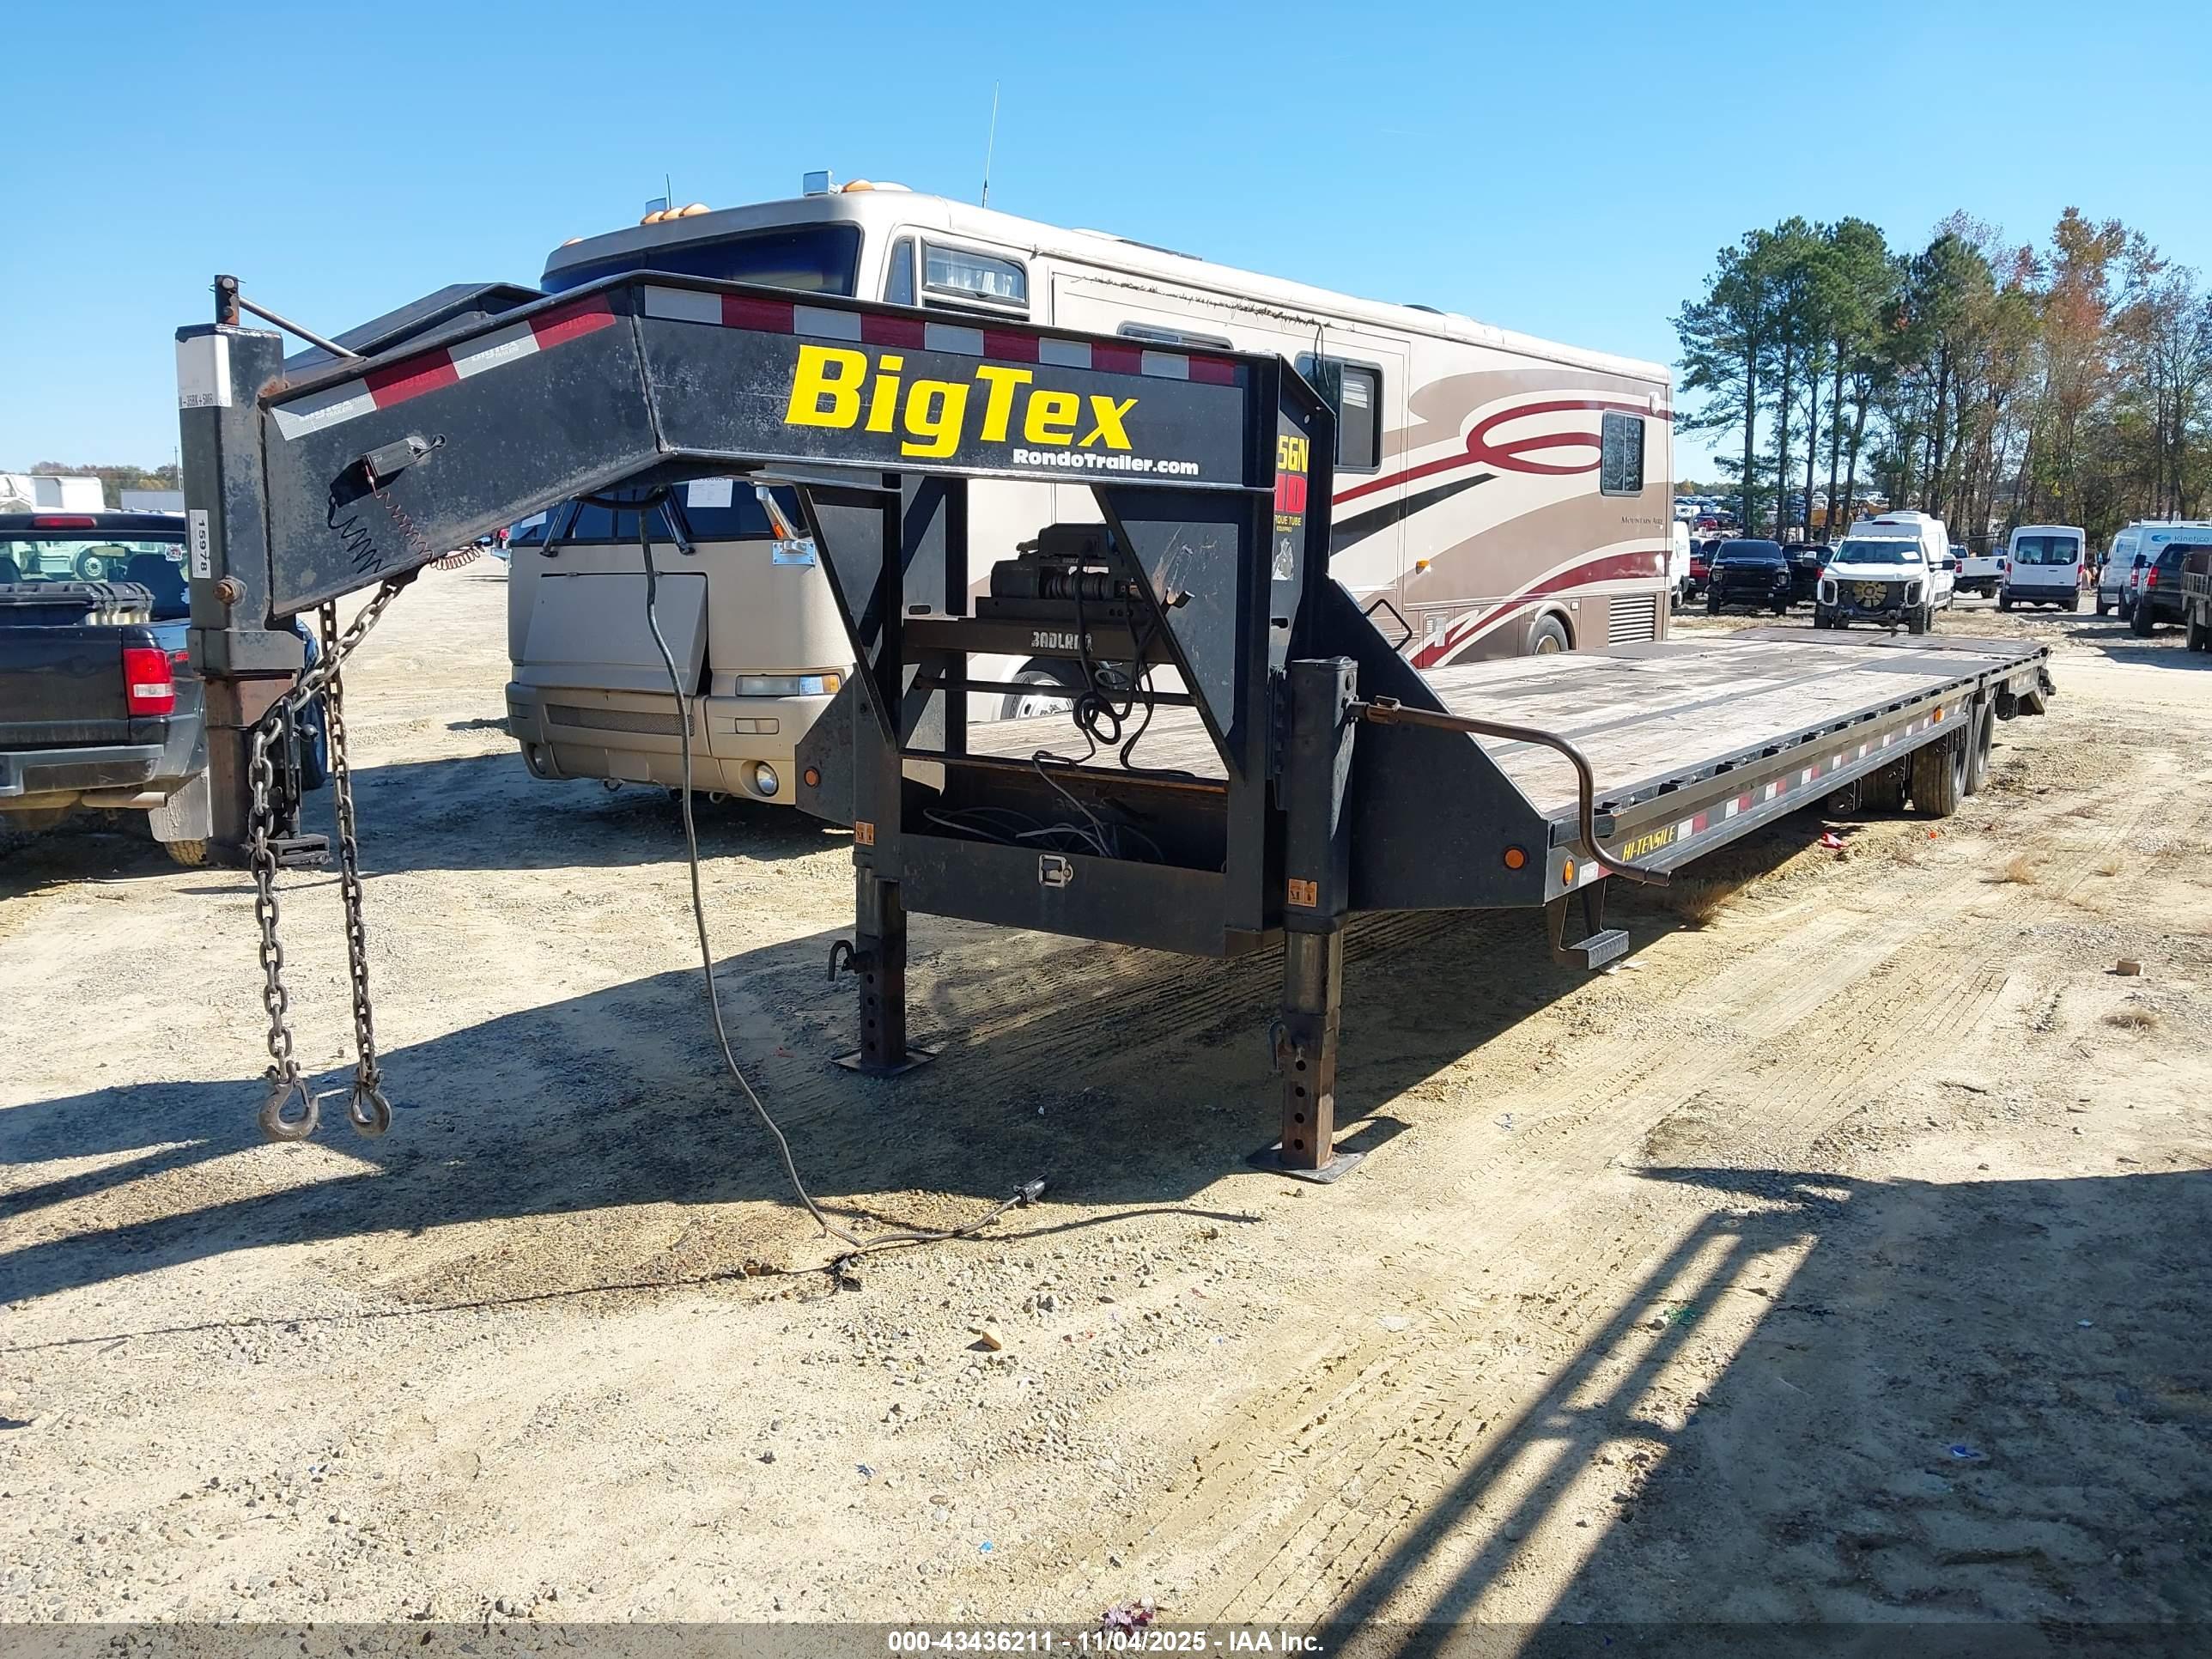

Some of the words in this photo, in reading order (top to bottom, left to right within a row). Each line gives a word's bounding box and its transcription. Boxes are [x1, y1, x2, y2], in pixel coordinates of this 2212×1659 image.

[784, 344, 1139, 458] BigTex
[1012, 448, 1200, 475] RondoTrailer.com
[1289, 516, 1302, 526] TUBE
[198, 519, 209, 572] 15978
[1622, 825, 1675, 861] HI-TENSILE
